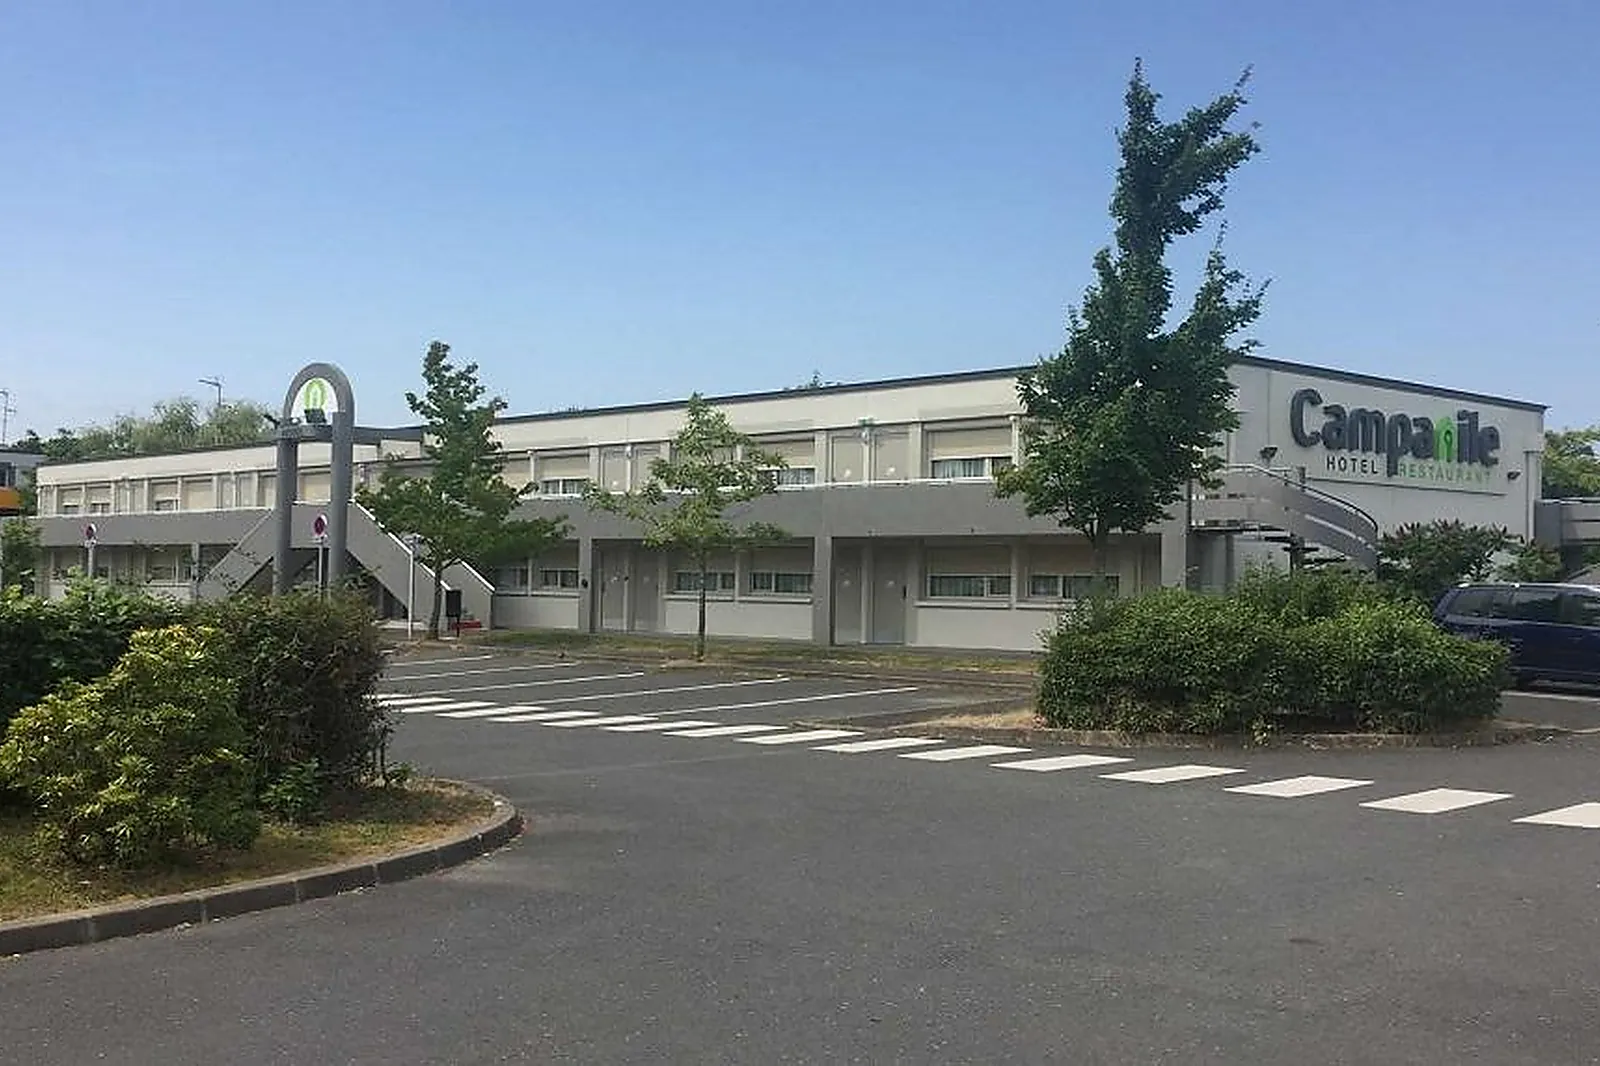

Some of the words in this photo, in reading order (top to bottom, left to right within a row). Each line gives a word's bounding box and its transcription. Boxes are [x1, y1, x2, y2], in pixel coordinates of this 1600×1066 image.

[1290, 389, 1500, 477] Campanile
[1326, 456, 1378, 474] HOTEL
[1399, 464, 1491, 483] RESTAURANT
